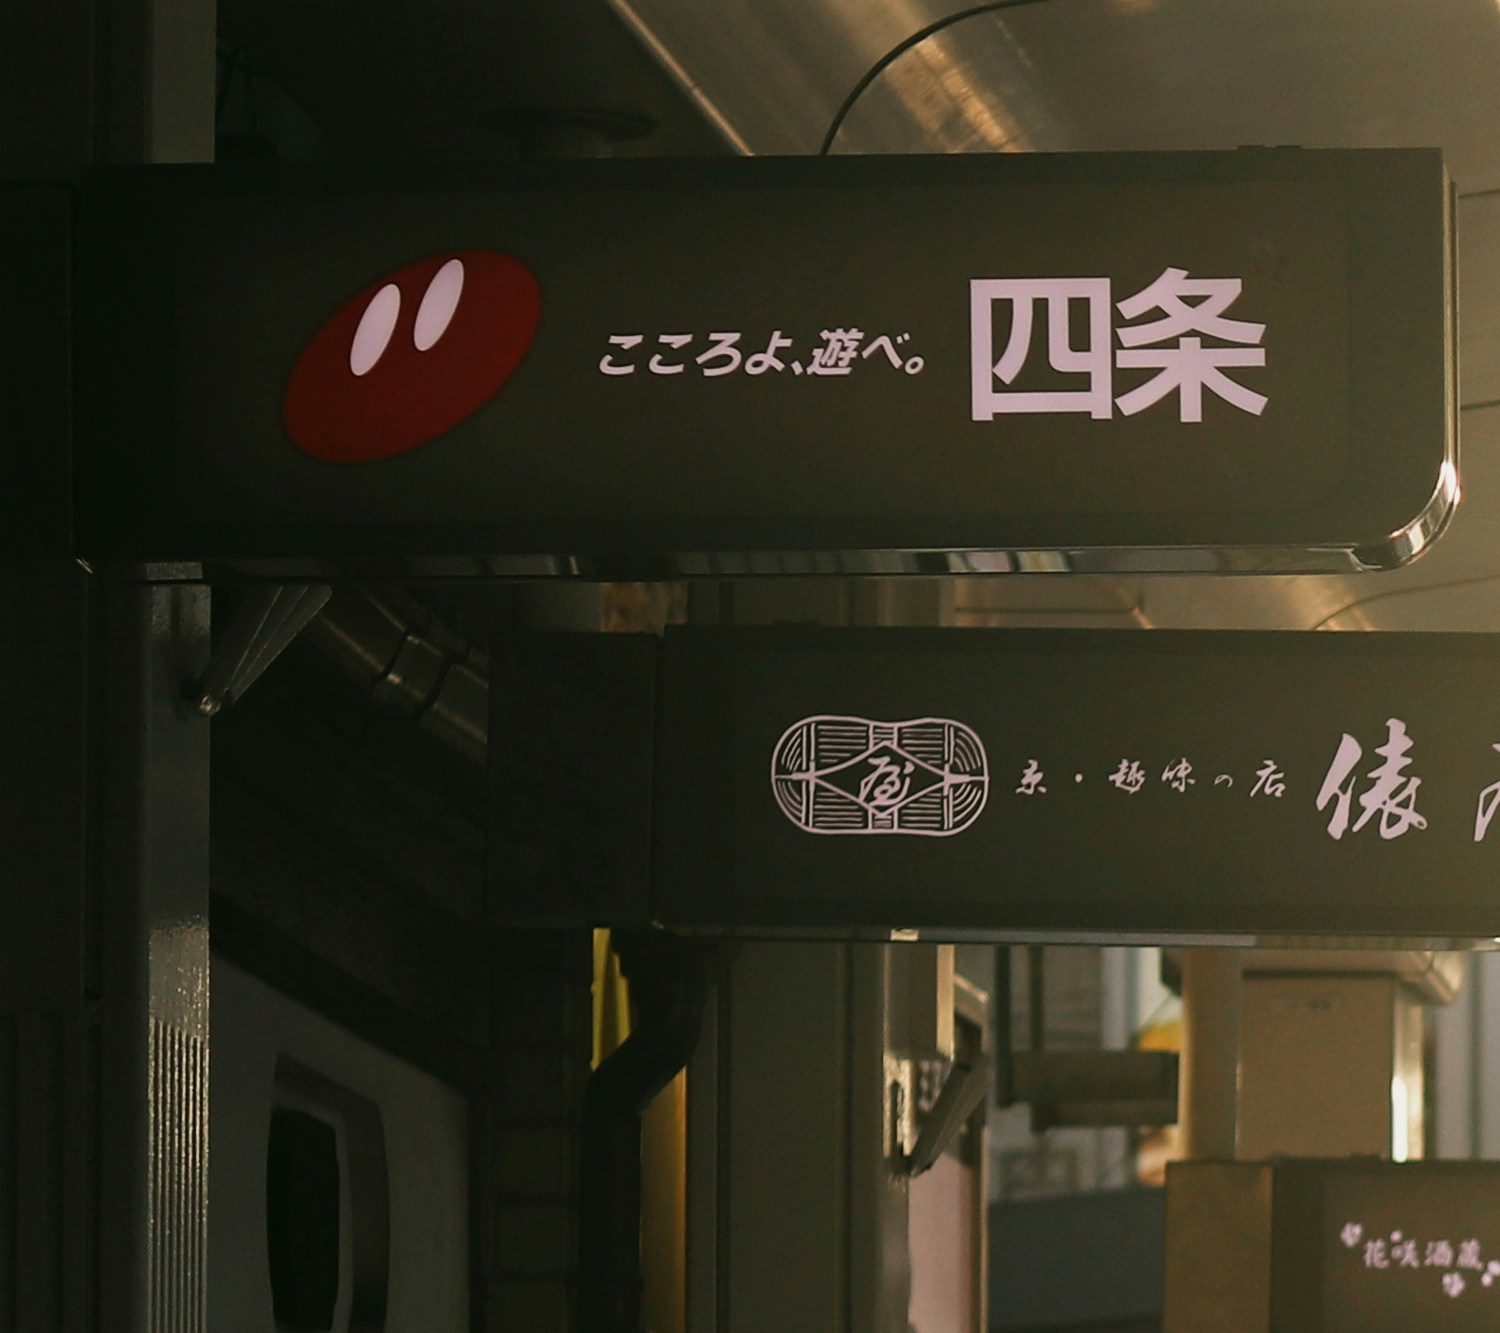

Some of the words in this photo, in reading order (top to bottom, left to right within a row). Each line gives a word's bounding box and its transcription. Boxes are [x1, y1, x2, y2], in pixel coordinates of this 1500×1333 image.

[599, 328, 926, 378] こころよ、遊べ。
[970, 267, 1268, 423] 四条
